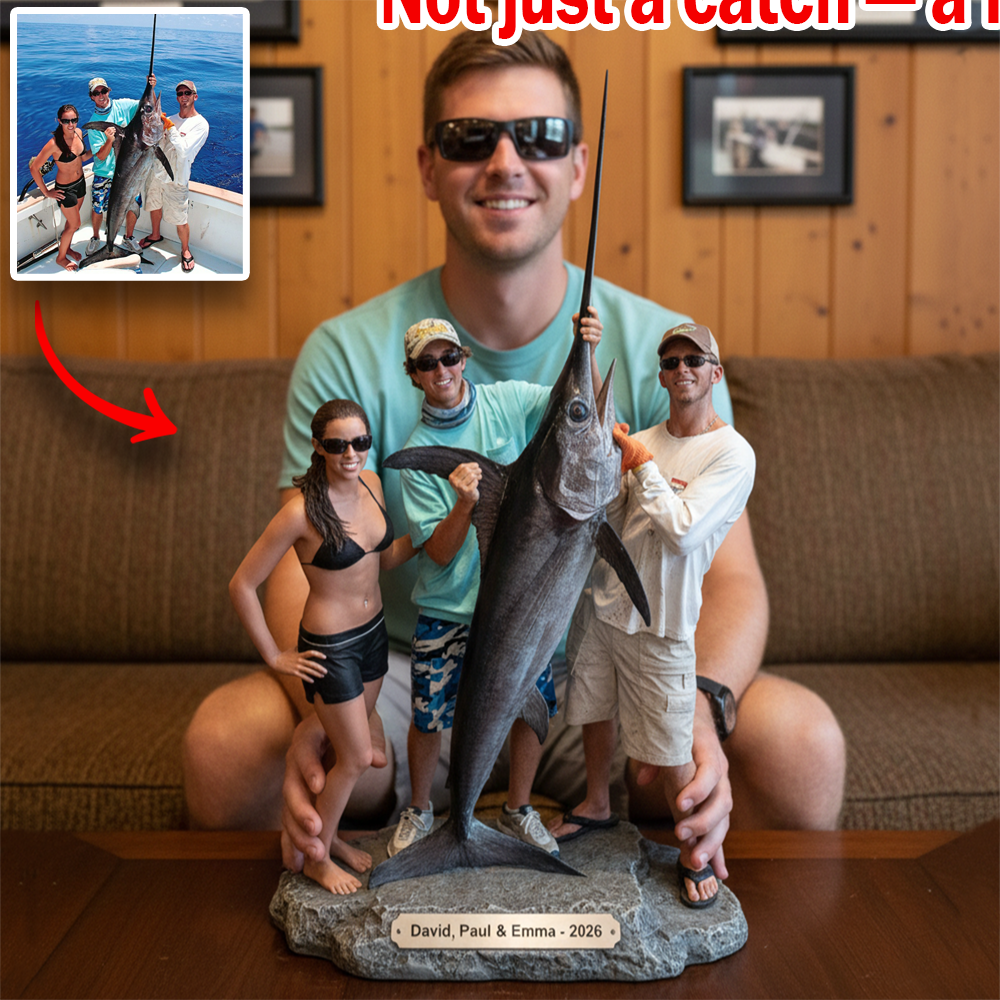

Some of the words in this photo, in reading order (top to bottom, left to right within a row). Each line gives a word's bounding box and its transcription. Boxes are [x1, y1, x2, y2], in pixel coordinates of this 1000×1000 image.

[411, 924, 455, 941] David,
[459, 924, 491, 938] Paul
[496, 924, 507, 938] &
[511, 924, 556, 938] Emma
[569, 924, 602, 938] 2026
